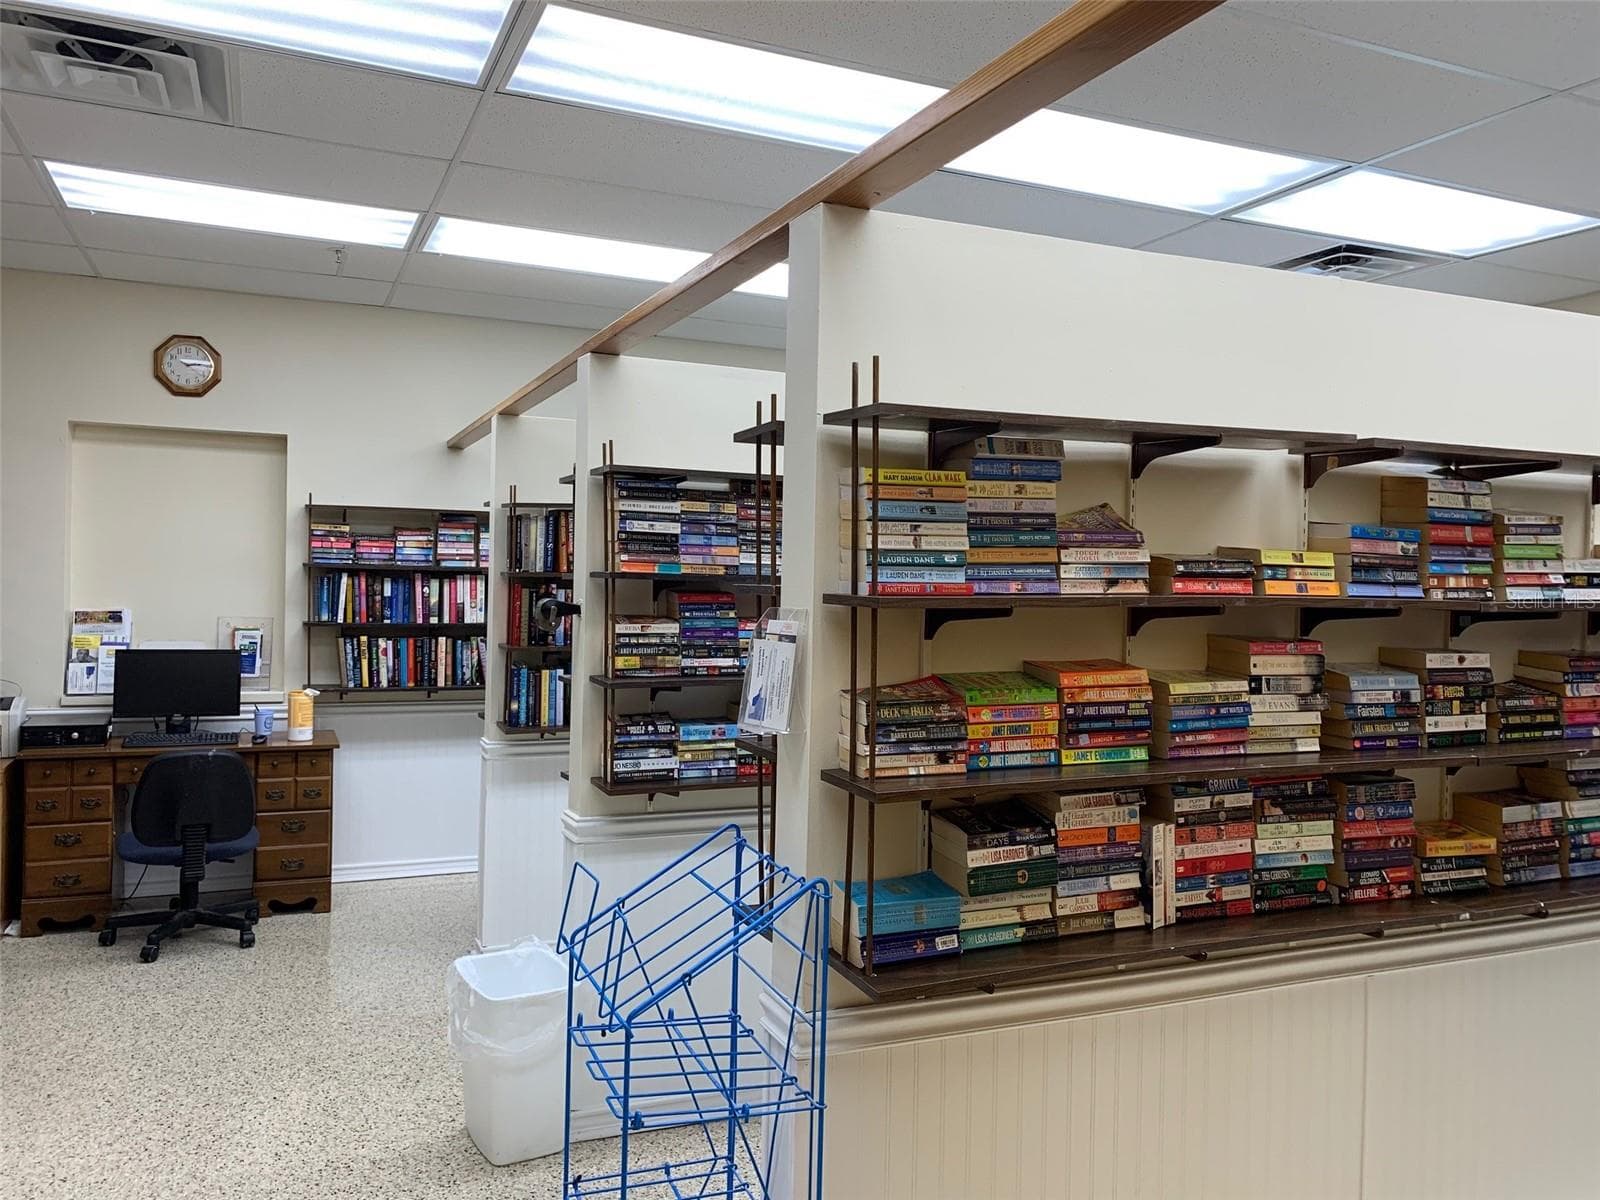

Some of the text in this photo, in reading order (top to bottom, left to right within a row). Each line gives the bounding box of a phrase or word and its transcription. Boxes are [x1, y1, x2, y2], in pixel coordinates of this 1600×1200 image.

[924, 472, 941, 482] CLAM
[944, 472, 962, 482] WAKE
[1084, 689, 1128, 699] JANET EVANOVICH
[880, 708, 900, 718] DECK
[910, 706, 934, 716] HALLS
[1084, 706, 1098, 715] JANET
[1100, 706, 1126, 714] EVANOVICH
[1358, 706, 1385, 717] Fairstein
[992, 725, 1006, 736] JANET
[1006, 724, 1032, 736] EVANOVICH
[990, 741, 1004, 752] JANET
[1005, 739, 1032, 751] EVANOVICH
[1073, 749, 1130, 760] JANET EVANOVICH
[990, 756, 1004, 767] JANET
[1005, 754, 1031, 766] EVANOVICH
[1208, 779, 1239, 792] GRAVITY
[986, 838, 1010, 847] DAYS
[990, 848, 1025, 862] LISA GARDNER
[1354, 888, 1378, 898] HELLFIRE
[975, 931, 1014, 944] LISA GARDNER
